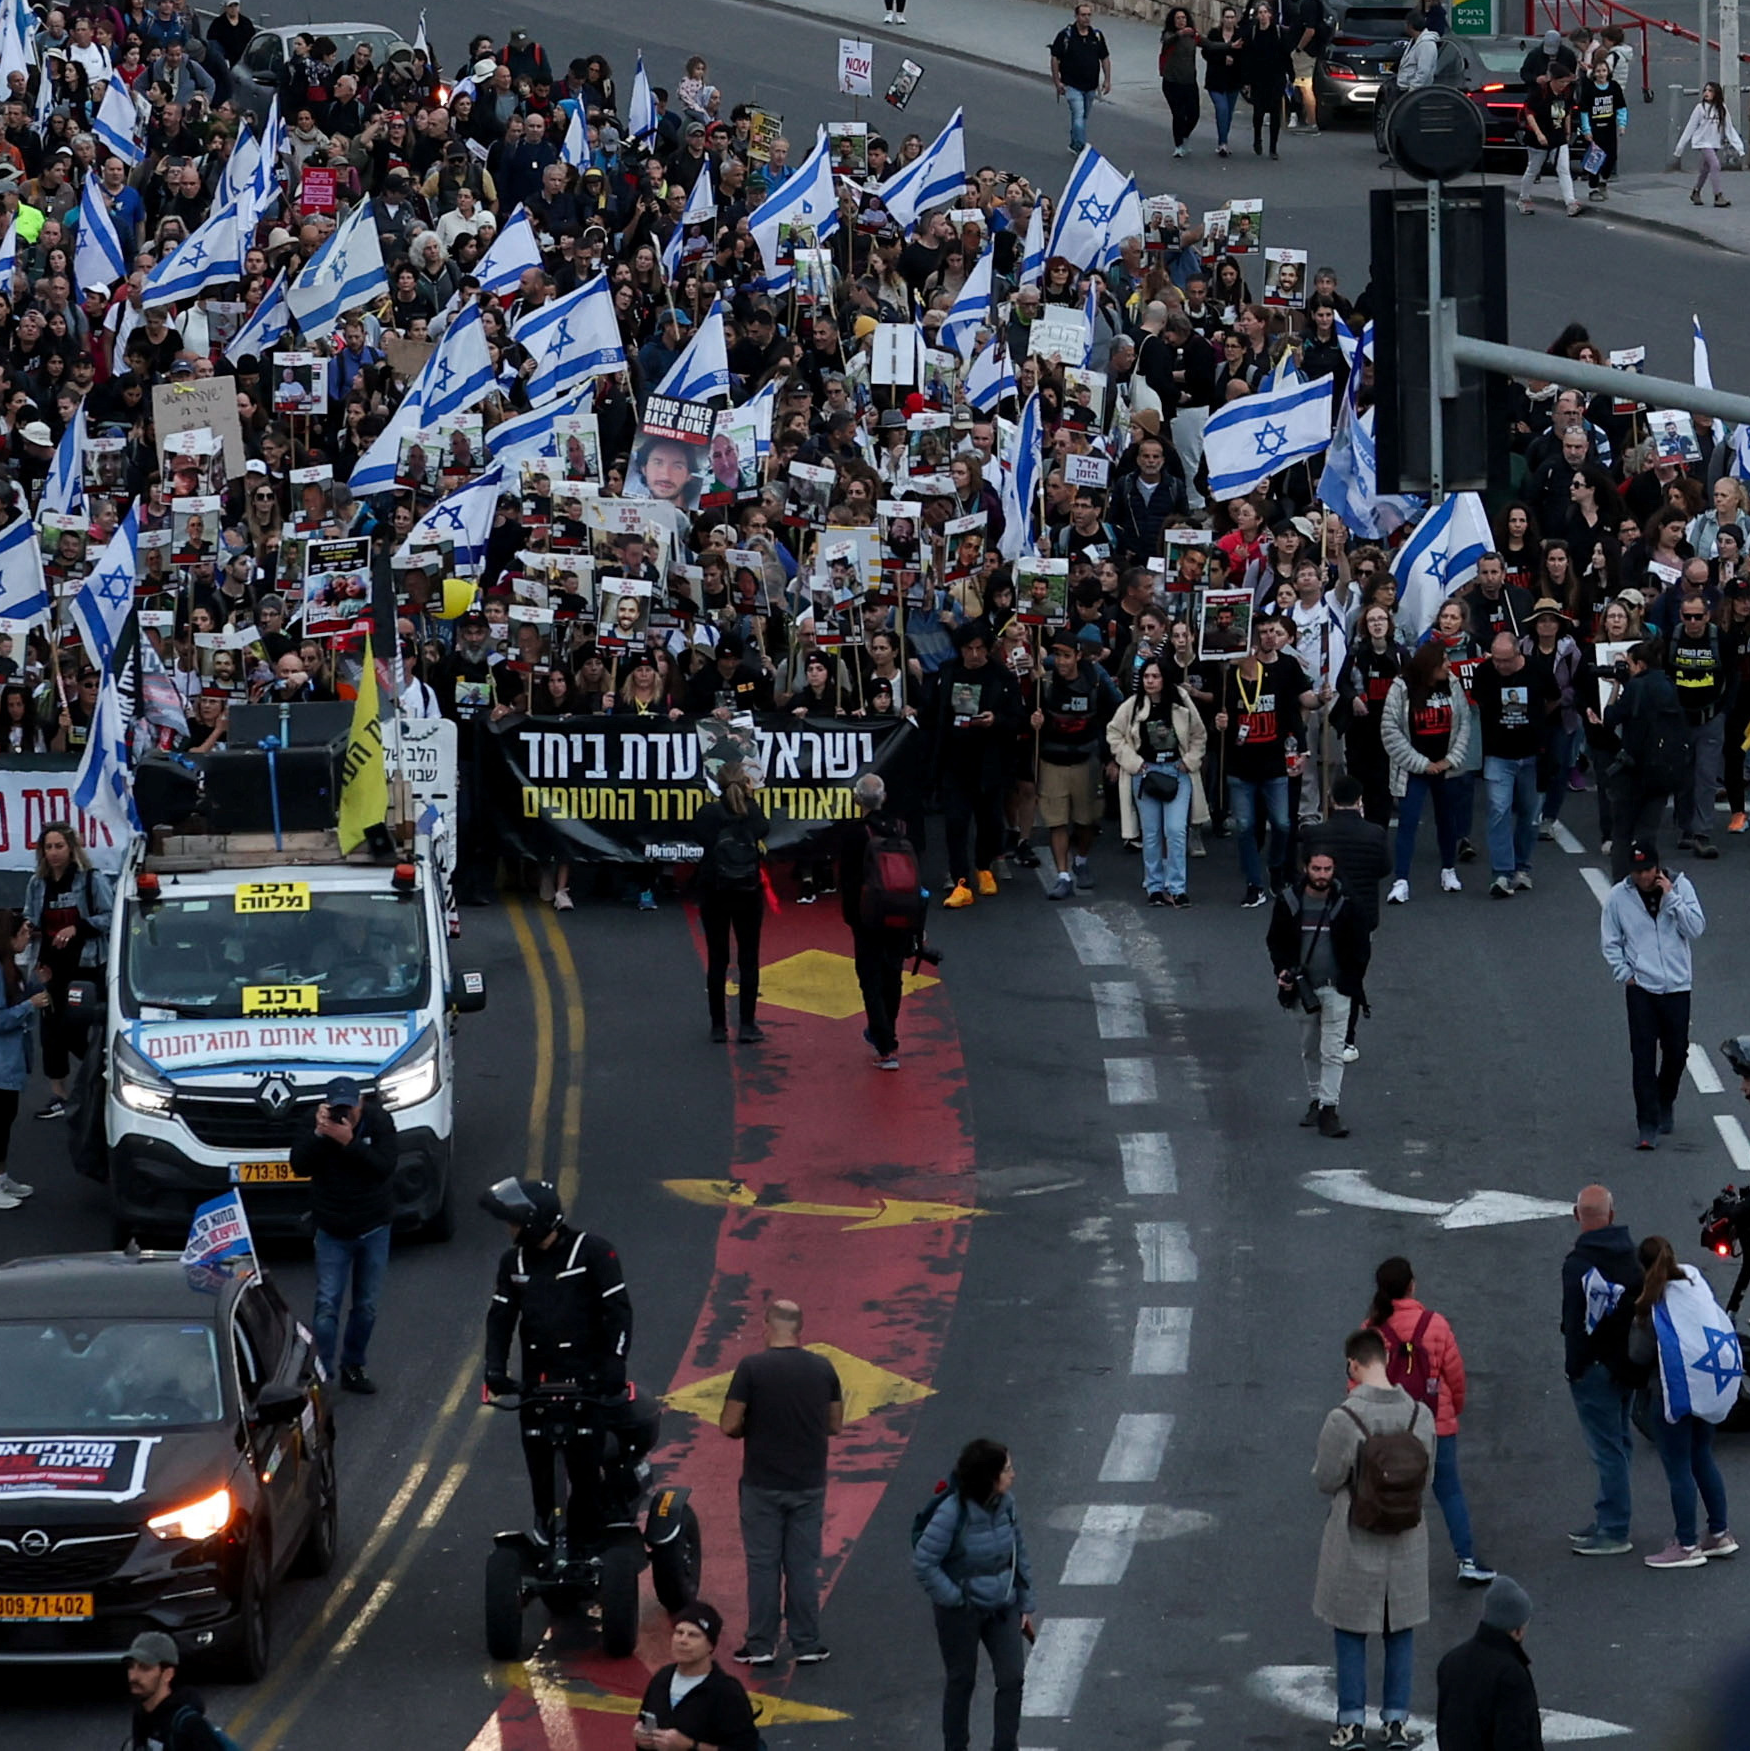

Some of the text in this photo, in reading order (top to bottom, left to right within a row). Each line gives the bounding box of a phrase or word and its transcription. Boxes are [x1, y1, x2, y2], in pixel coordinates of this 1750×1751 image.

[845, 57, 870, 74] NOW
[646, 396, 714, 422] BRING OMER
[644, 410, 710, 436] BACK HOME
[406, 746, 437, 763] הלב
[519, 731, 608, 780] ביחד
[756, 730, 874, 780] ישראל
[409, 769, 438, 783] שבוי
[522, 786, 636, 821] החטופים
[250, 883, 295, 894] רכב
[241, 895, 304, 910] מלווה
[258, 989, 302, 1005] רכב
[147, 1027, 399, 1059] תוציאו אותם מהגיהנום
[25, 1441, 117, 1456] מחזירים
[38, 1453, 115, 1468] הביתה
